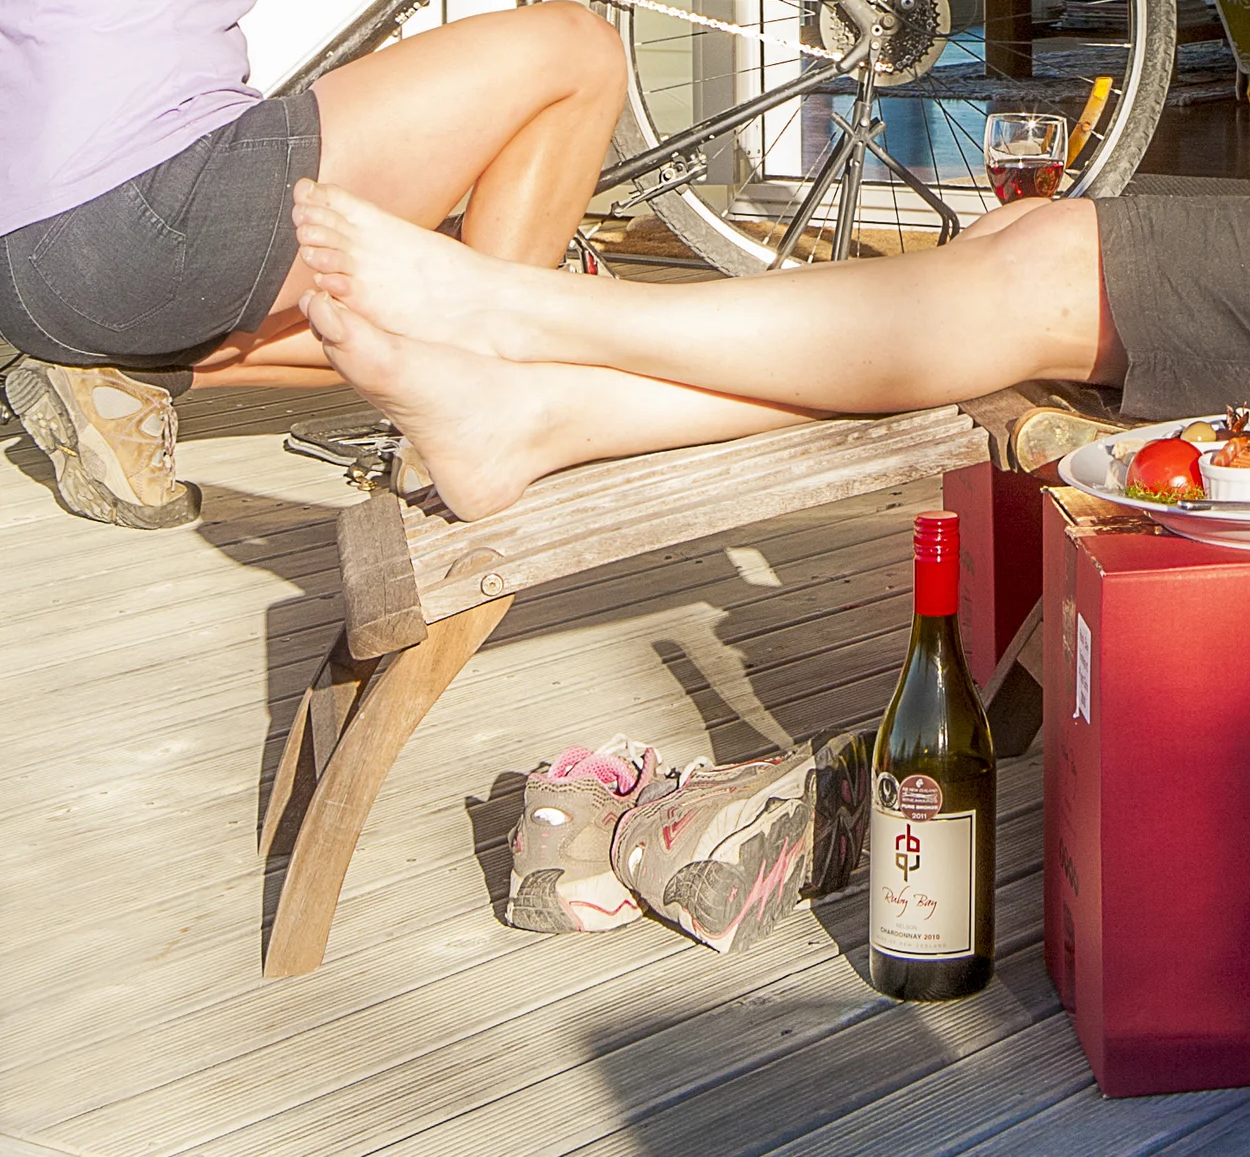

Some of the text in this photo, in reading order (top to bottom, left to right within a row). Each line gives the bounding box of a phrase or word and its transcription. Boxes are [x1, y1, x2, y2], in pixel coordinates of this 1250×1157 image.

[882, 885, 938, 921] Ruby Bay
[880, 926, 922, 939] CHARDONNAY
